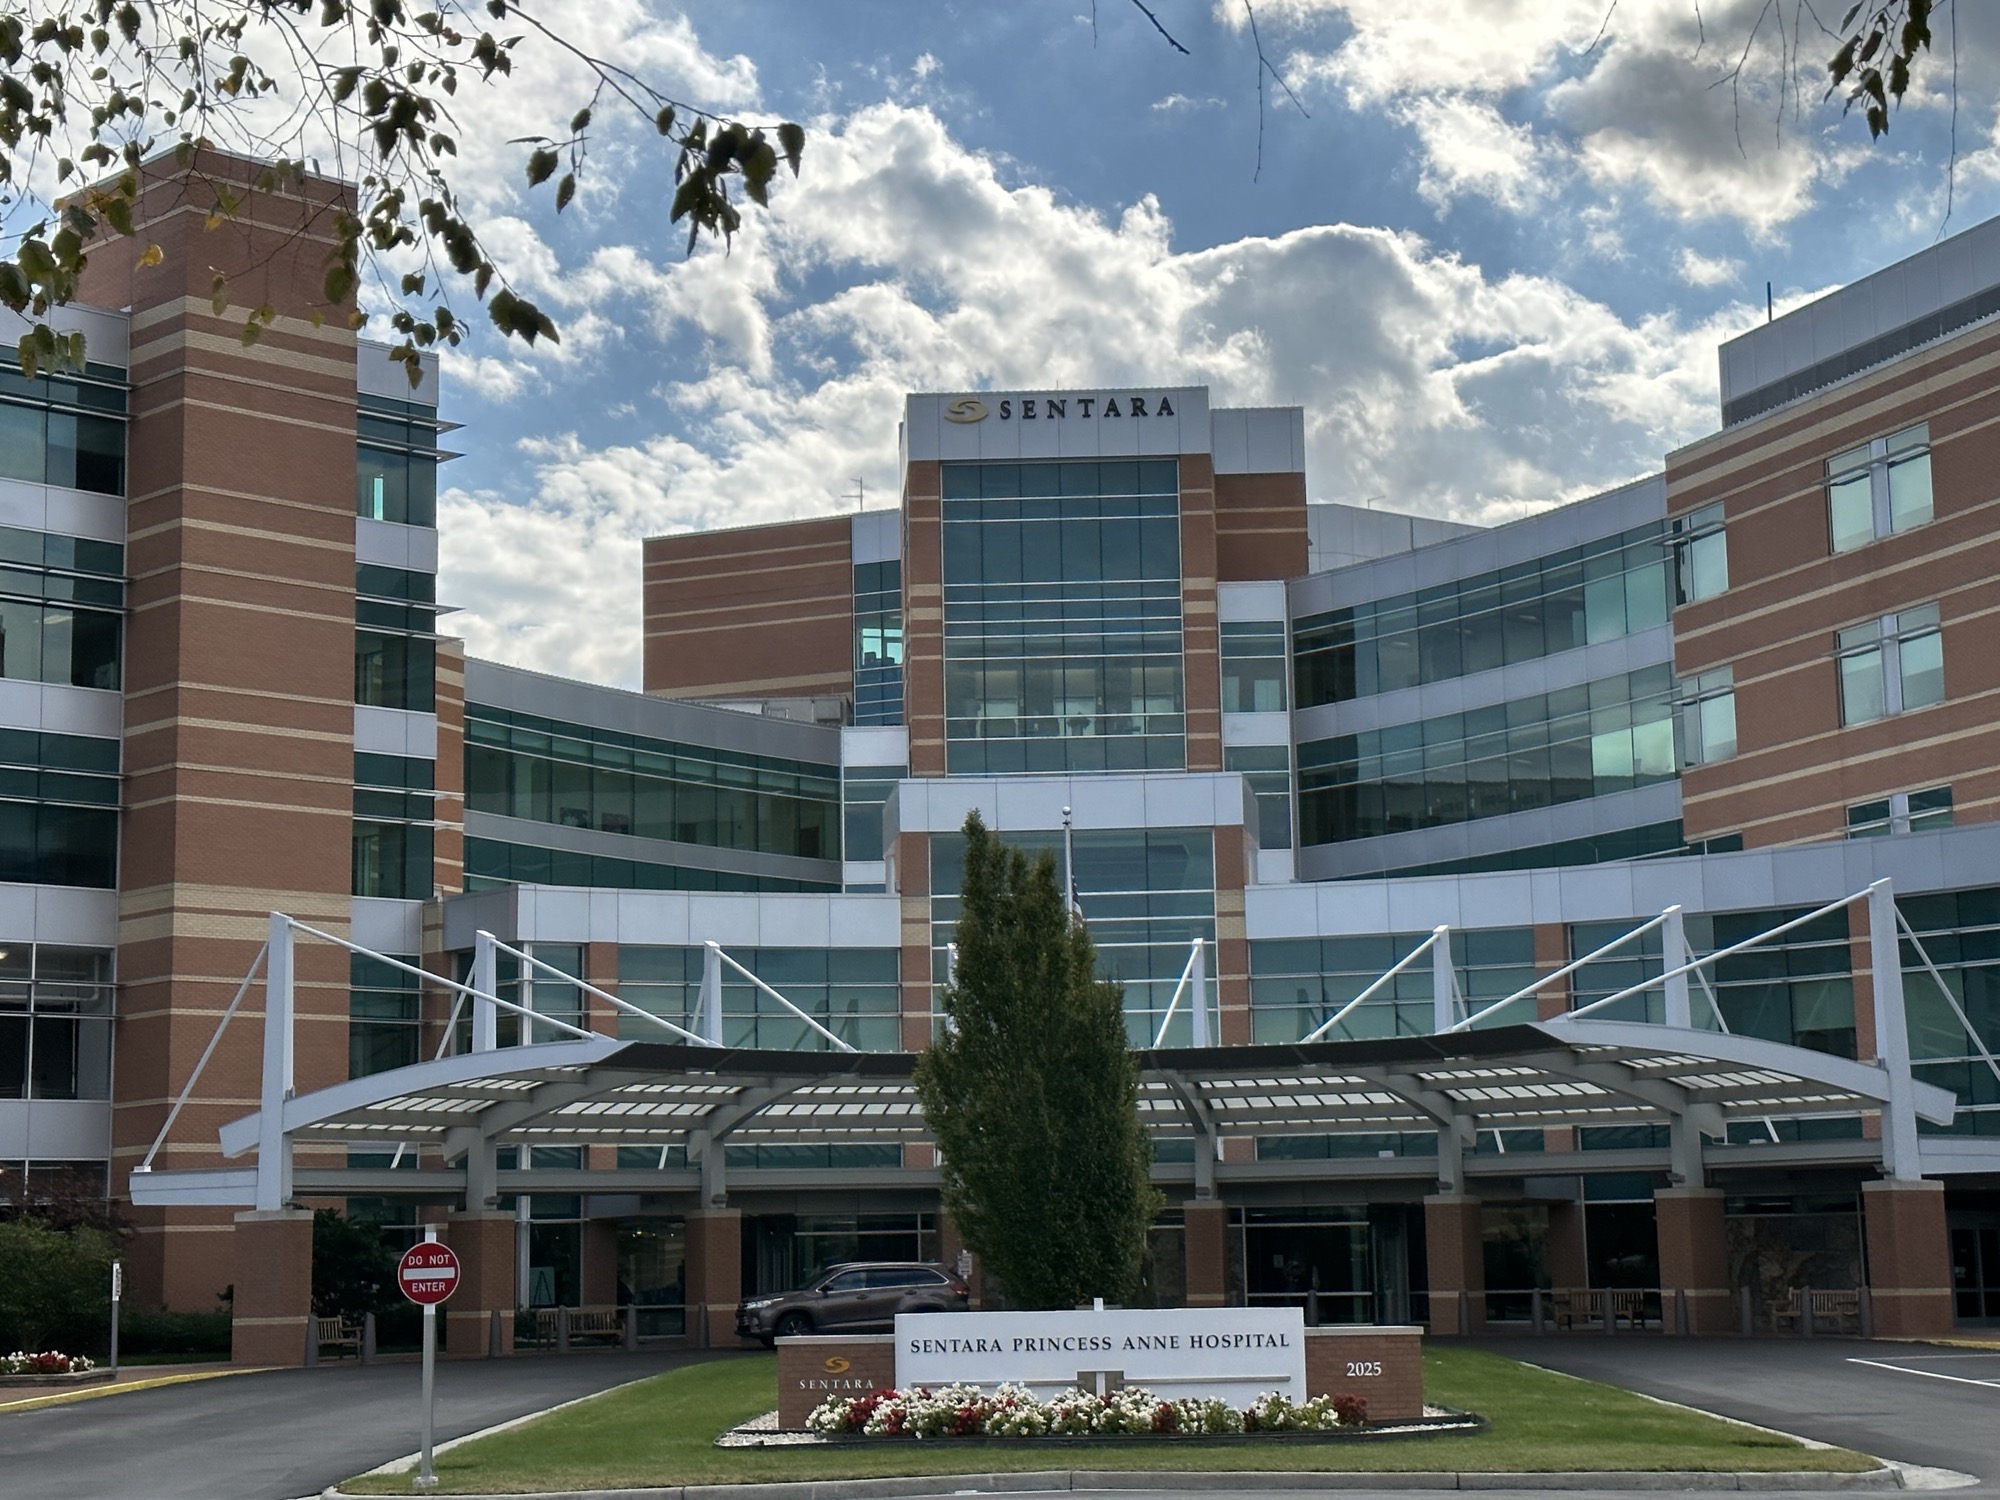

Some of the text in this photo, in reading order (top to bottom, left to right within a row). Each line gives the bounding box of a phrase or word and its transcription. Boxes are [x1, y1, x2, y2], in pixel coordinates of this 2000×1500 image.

[1000, 396, 1175, 420] SENTARA
[408, 1254, 450, 1266] DO NOT
[412, 1281, 446, 1293] ENTER
[910, 1333, 1290, 1353] SENTARA PRINCESS ANNE HOSPITAL
[1346, 1361, 1382, 1377] 2025
[799, 1379, 874, 1390] SENTARA
